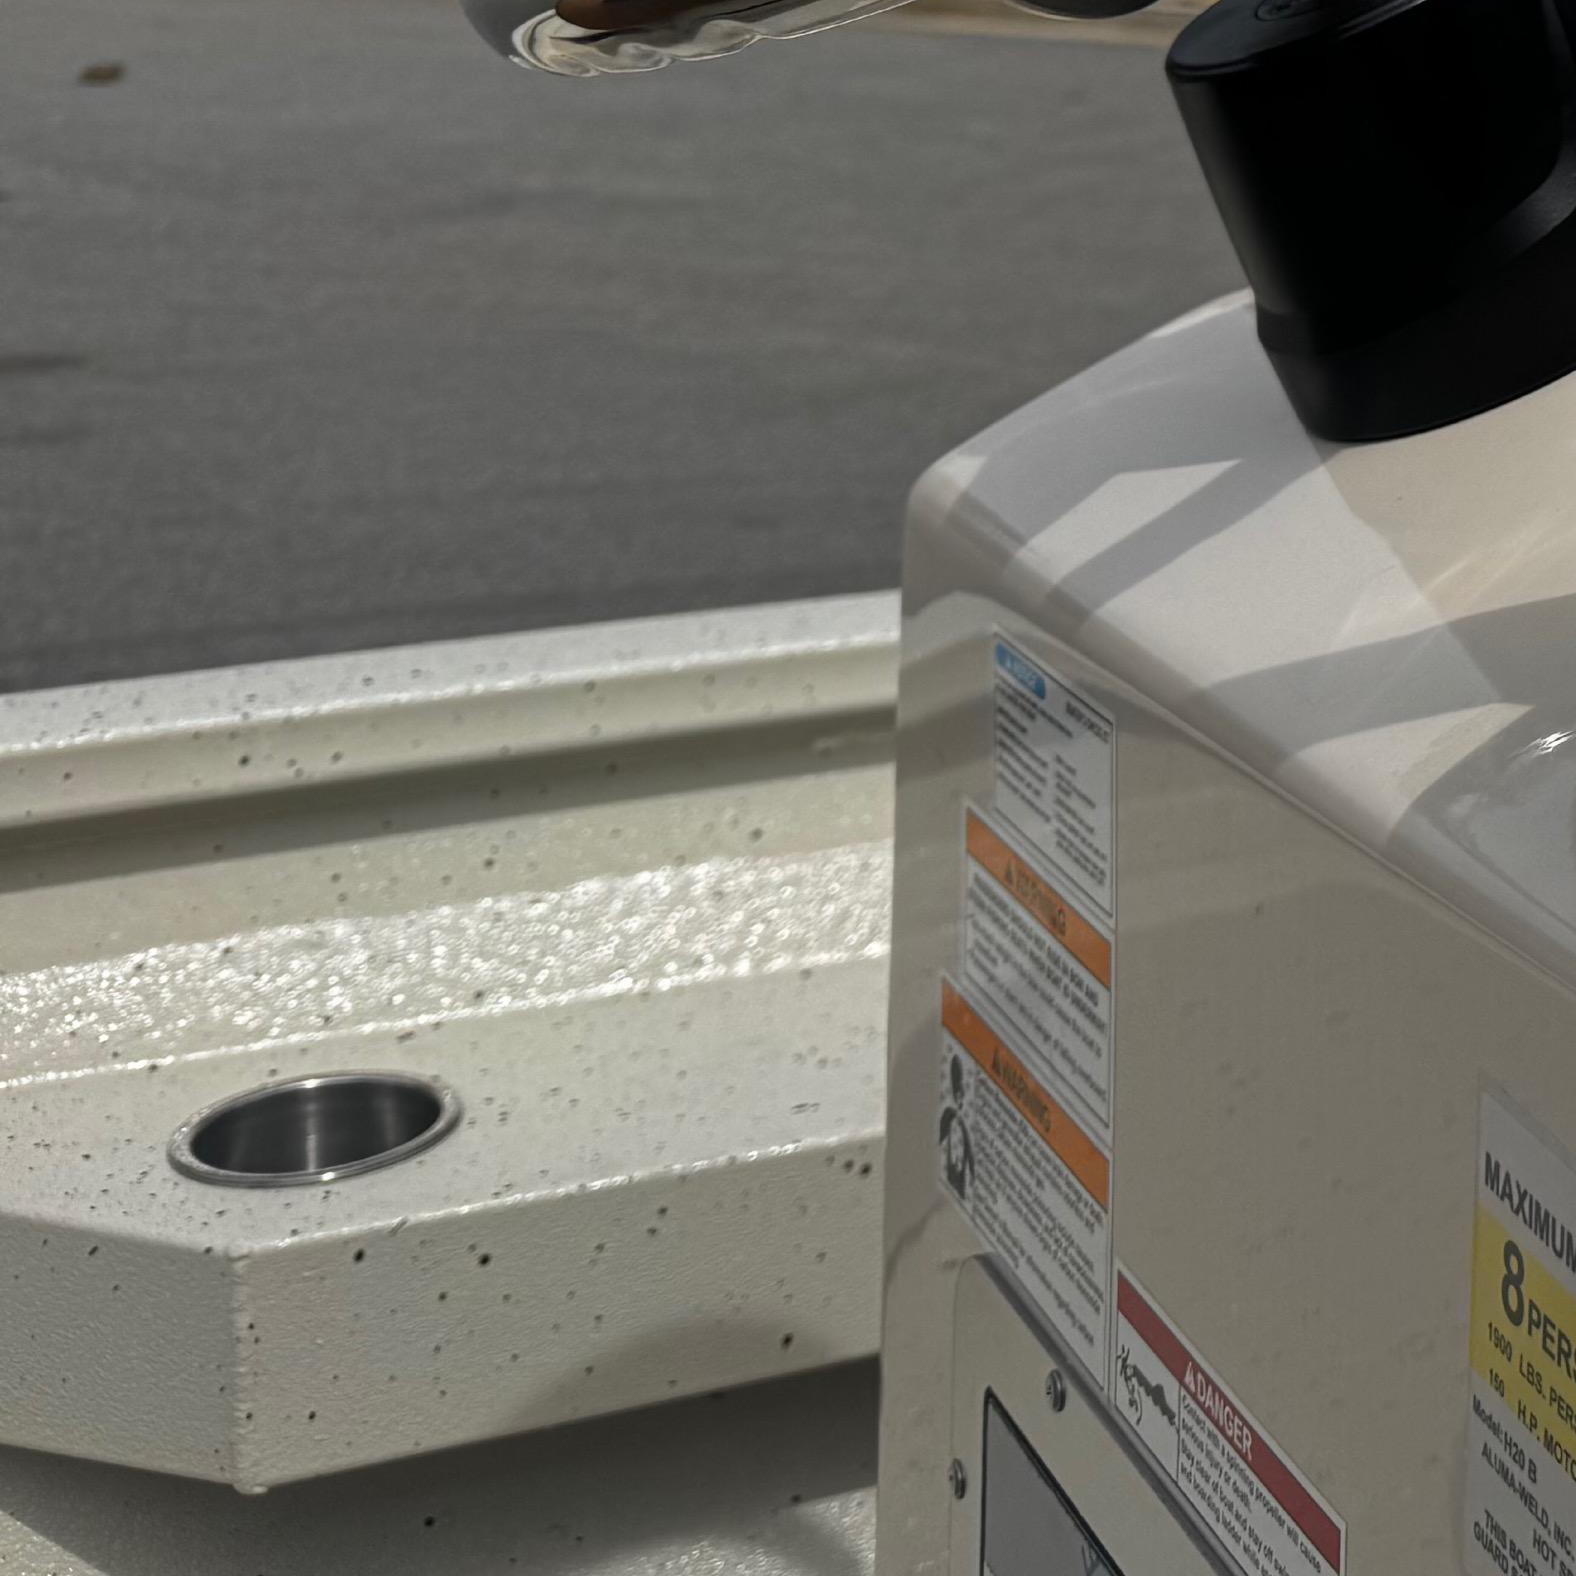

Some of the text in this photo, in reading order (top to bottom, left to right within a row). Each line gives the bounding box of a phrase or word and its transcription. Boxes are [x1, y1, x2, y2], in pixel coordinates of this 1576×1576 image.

[1501, 1239, 1525, 1327] 8
[1488, 1321, 1513, 1363] 1900
[1488, 1368, 1505, 1399] 150
[1196, 1371, 1253, 1461] DANGER
[1527, 1457, 1538, 1485] B
[1473, 1520, 1509, 1575] GUARD
[1484, 1507, 1508, 1551] THIS
[1533, 1527, 1557, 1571] HOT
